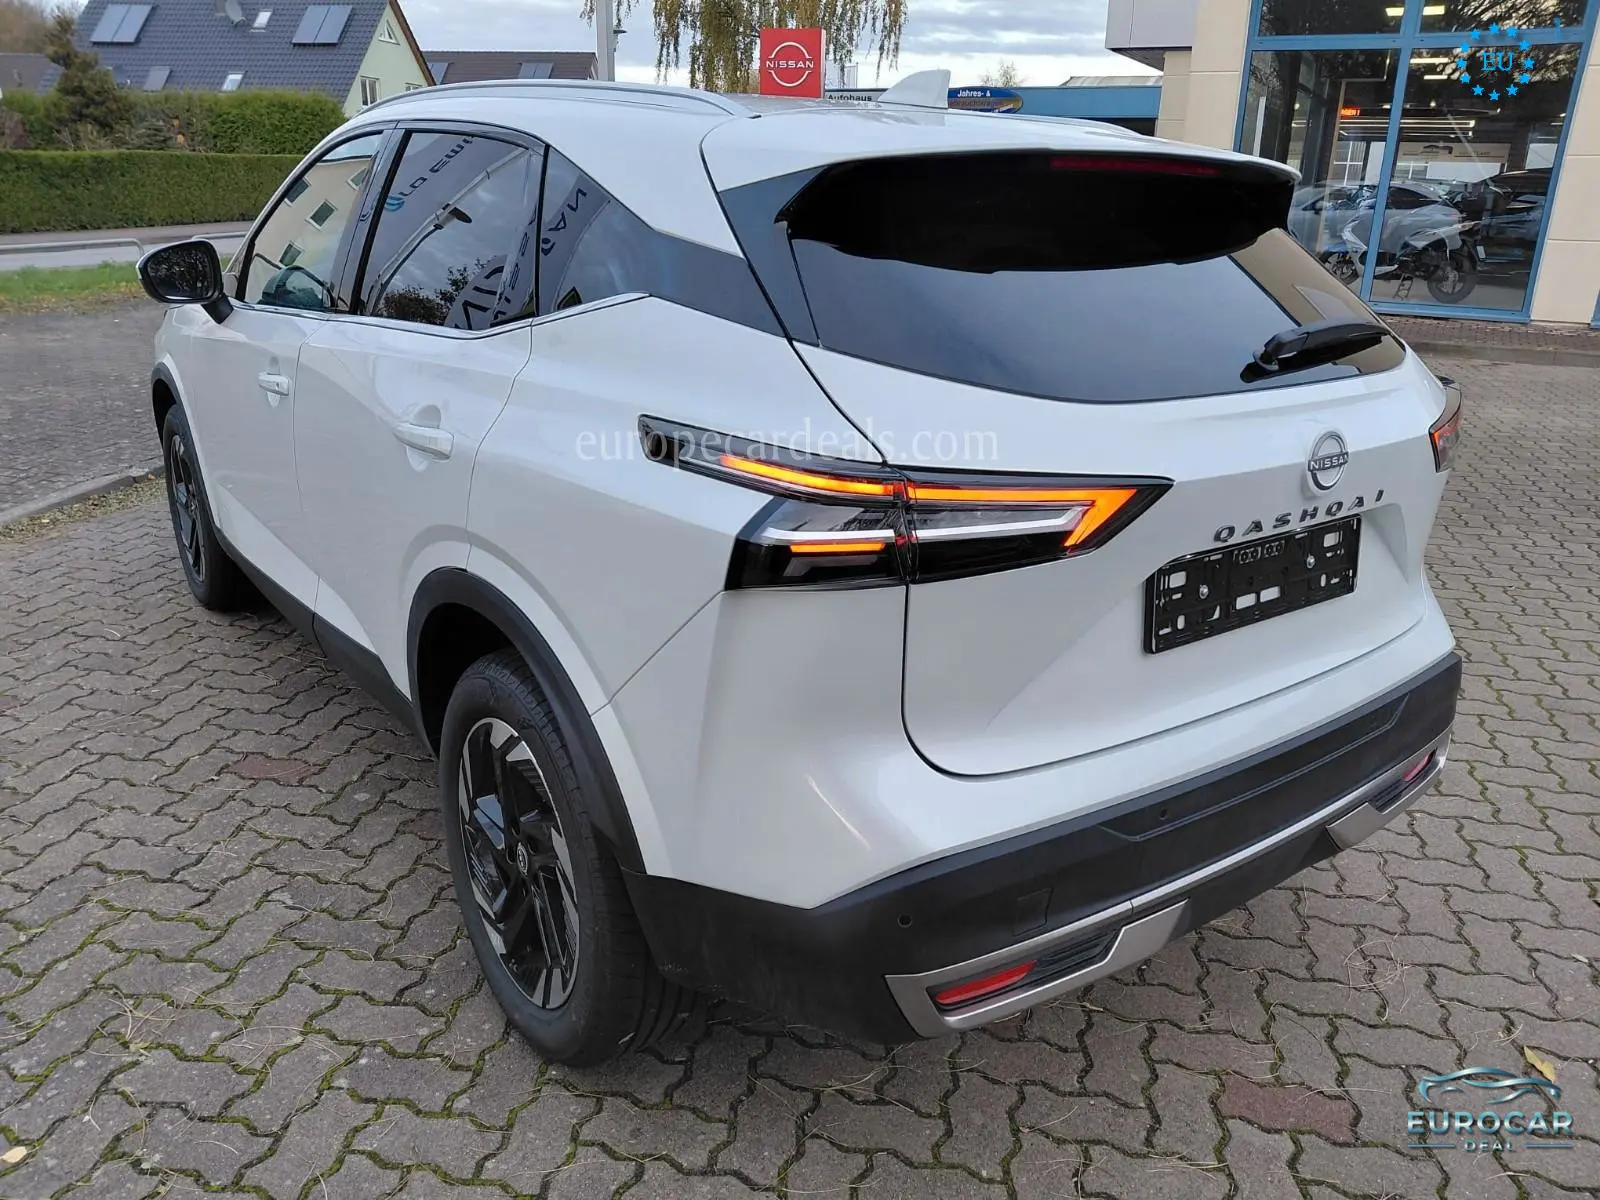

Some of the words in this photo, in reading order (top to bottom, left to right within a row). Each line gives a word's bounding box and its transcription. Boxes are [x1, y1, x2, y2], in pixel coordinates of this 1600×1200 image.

[766, 60, 814, 69] NISSAN
[828, 94, 872, 102] Autohaus
[1310, 453, 1349, 471] NISSAN
[1213, 489, 1385, 543] QASHQAI
